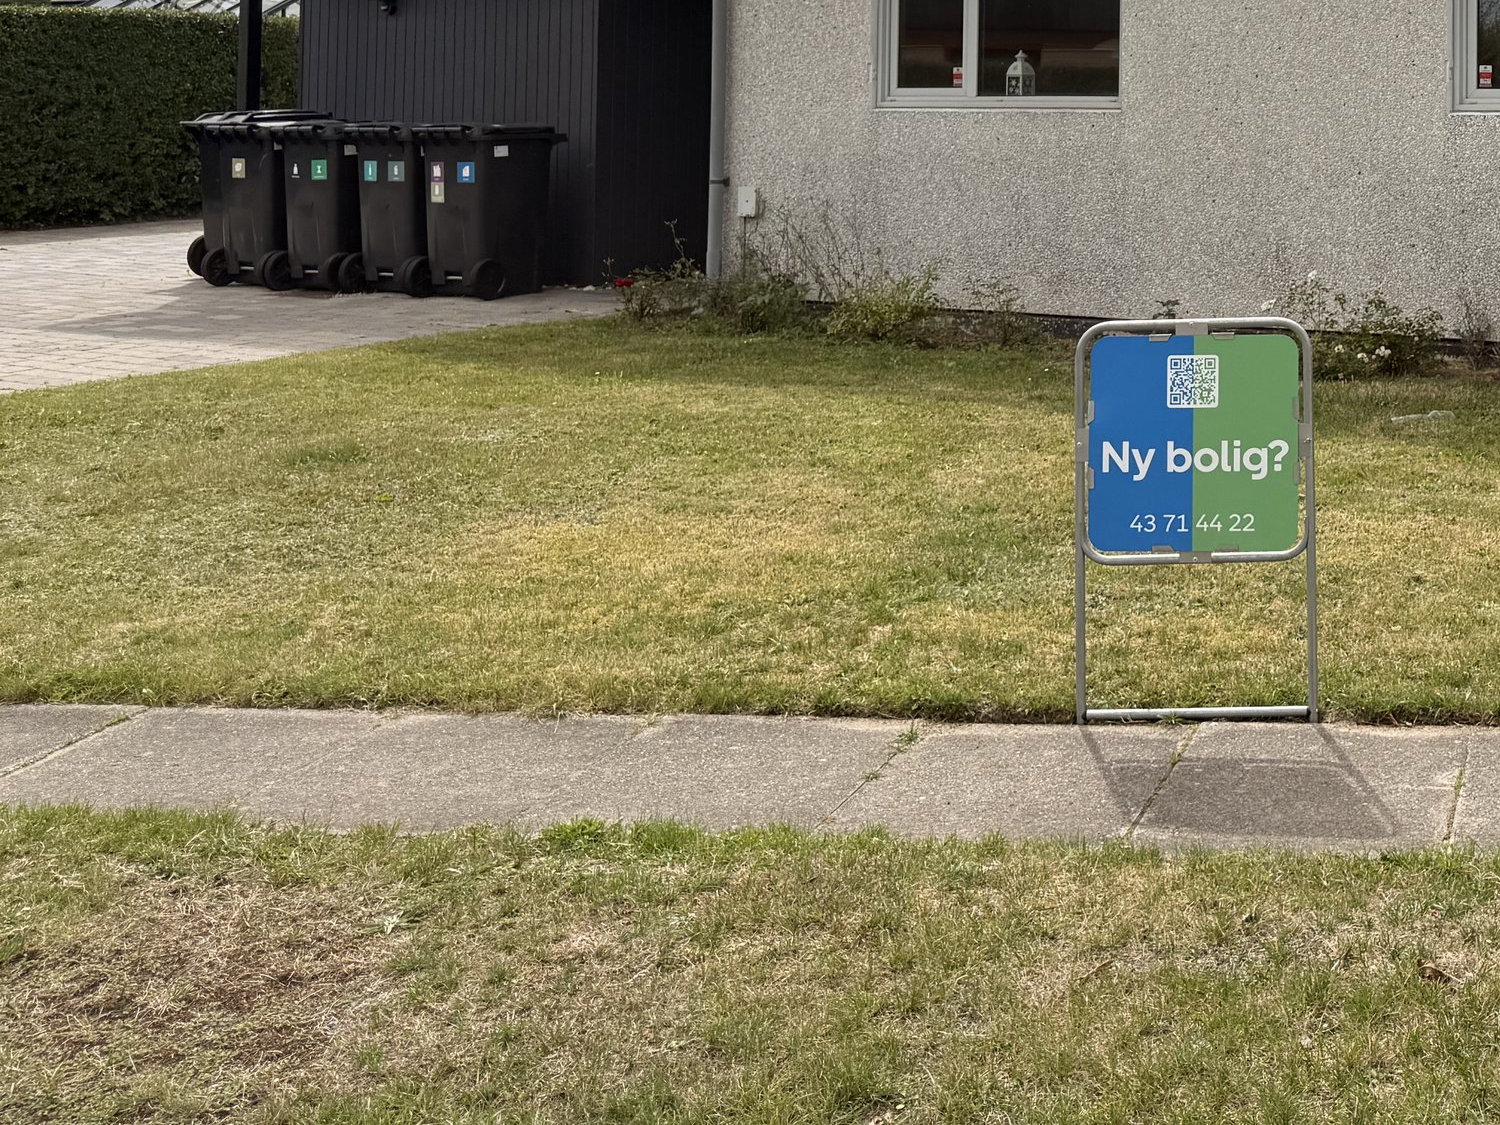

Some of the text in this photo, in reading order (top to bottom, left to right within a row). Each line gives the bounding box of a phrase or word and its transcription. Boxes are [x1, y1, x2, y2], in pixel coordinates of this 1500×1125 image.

[1101, 439, 1290, 481] Ny bolig?
[1129, 513, 1256, 533] 43 71 44 22
